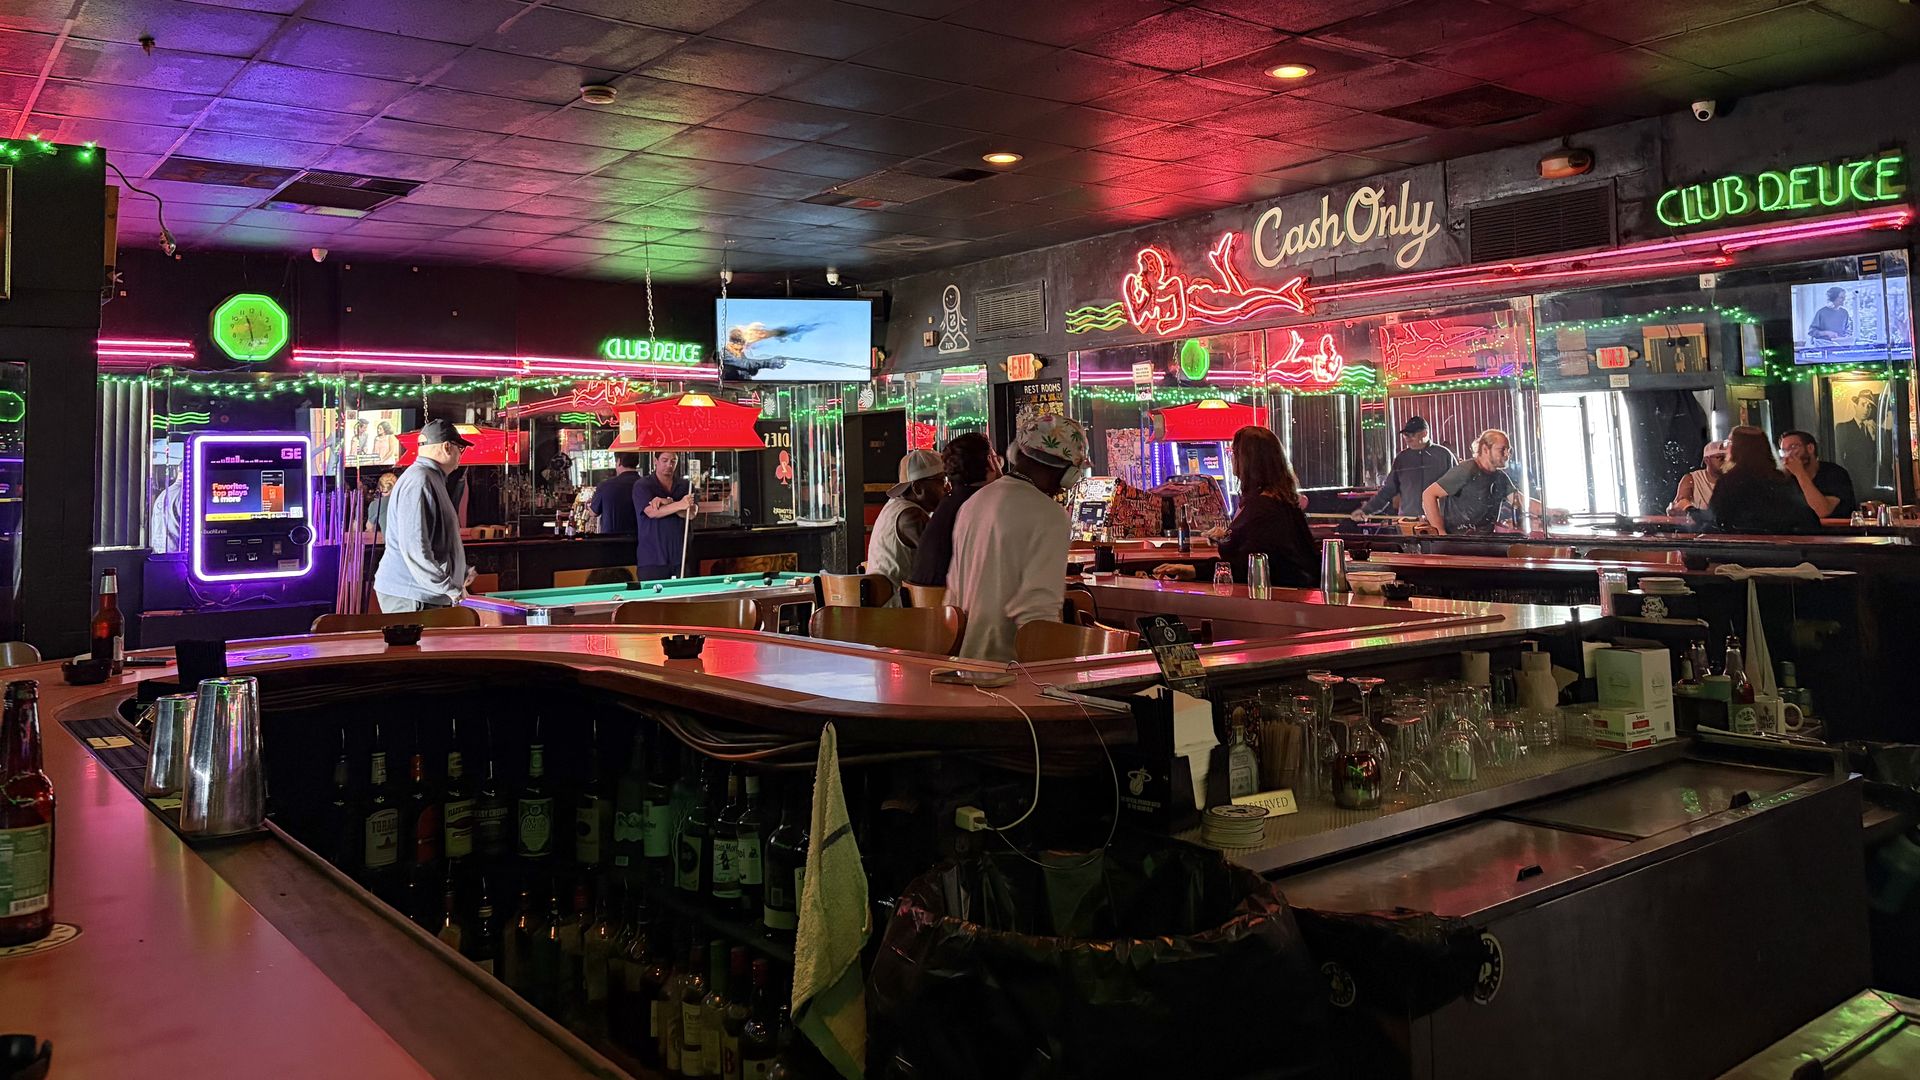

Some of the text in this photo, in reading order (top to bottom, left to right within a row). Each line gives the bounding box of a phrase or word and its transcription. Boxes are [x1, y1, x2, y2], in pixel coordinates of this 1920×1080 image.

[1656, 156, 1902, 226] CLUB DEUCE
[1252, 180, 1440, 271] Cash Only
[604, 338, 702, 363] CLUB DEUCE
[1011, 355, 1031, 379] EXIT
[1023, 382, 1061, 395] REST ROOMS
[212, 482, 249, 493] Favorites,
[212, 489, 248, 498] top plays
[1246, 797, 1289, 809] ESERVED
